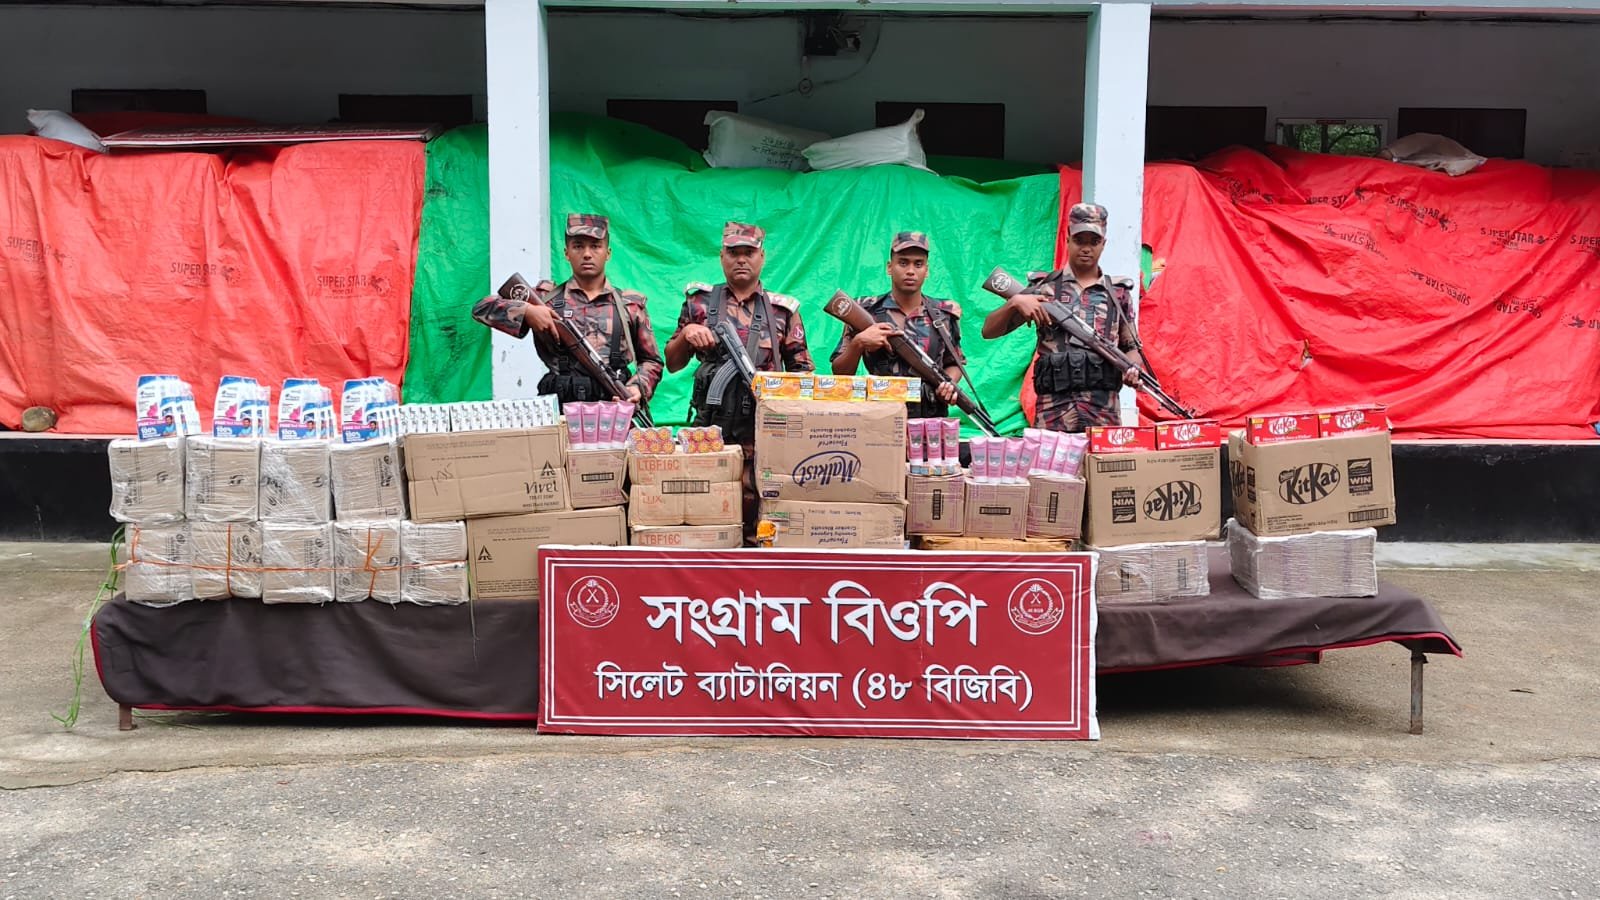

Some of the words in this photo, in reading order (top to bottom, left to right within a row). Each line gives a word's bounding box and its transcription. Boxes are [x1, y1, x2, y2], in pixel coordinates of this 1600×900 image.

[170, 262, 202, 275] SUPER
[317, 275, 345, 288] SUPER
[347, 275, 367, 288] STAR
[1425, 275, 1445, 293] STAR
[638, 459, 680, 471] LTBF16C
[800, 456, 855, 486] Malkist
[523, 480, 559, 494] Vivel
[1285, 463, 1339, 504] KitKat
[1350, 475, 1372, 485] WIN
[1113, 497, 1135, 506] WIN
[1146, 480, 1196, 521] KitKat
[640, 588, 812, 648] সংগ্রাম
[821, 579, 989, 647] বিওপি
[594, 661, 688, 702] সিলেট
[696, 662, 844, 703] ব্যাটালিয়ন
[853, 667, 910, 710] (৪৮
[924, 664, 1034, 712] বিজিবি)
